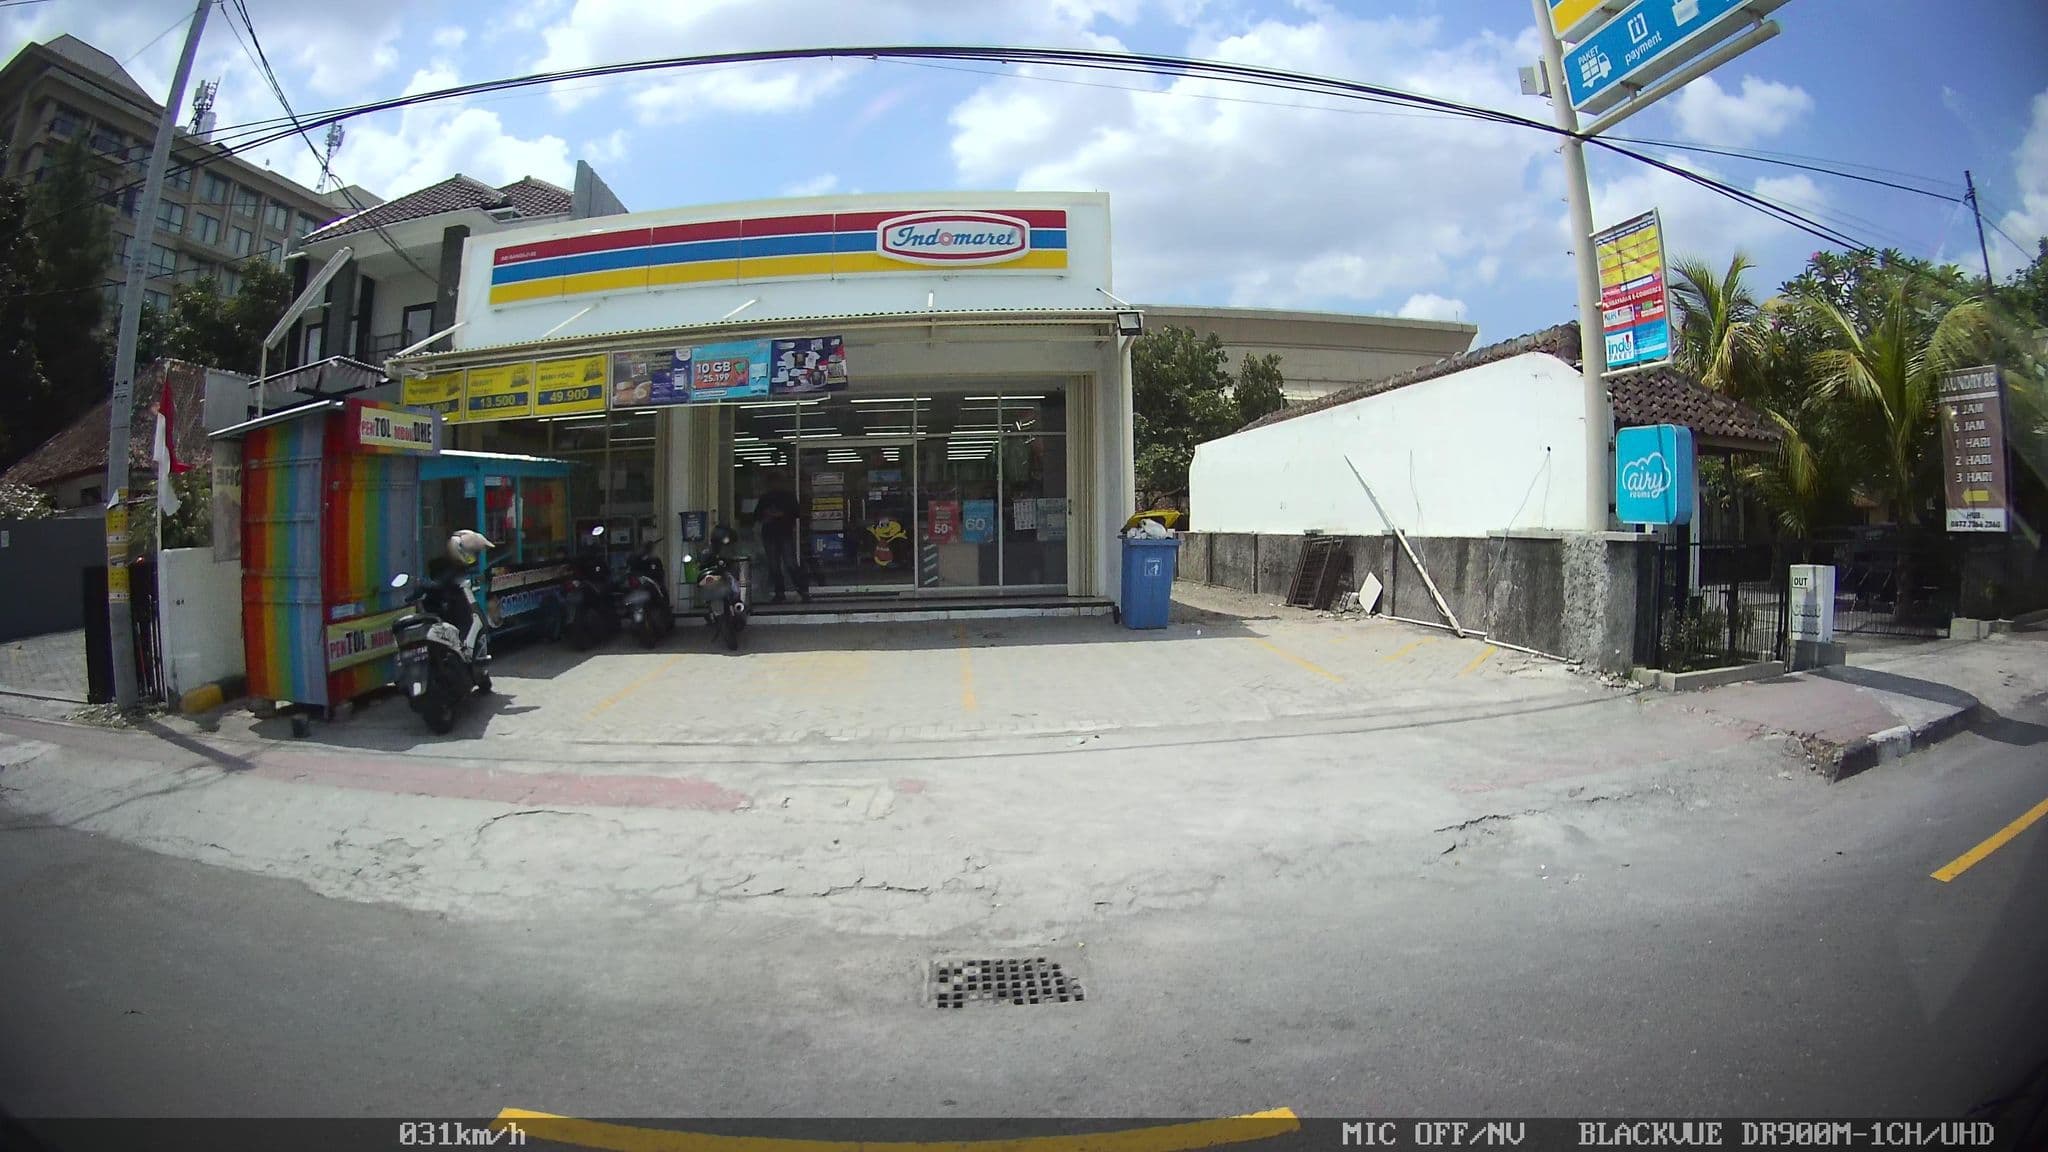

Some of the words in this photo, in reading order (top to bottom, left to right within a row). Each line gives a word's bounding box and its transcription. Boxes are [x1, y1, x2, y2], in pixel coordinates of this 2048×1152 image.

[1578, 45, 1599, 64] PAKET
[1625, 31, 1663, 66] payment
[893, 226, 1015, 247] Indomaret
[696, 363, 709, 374] 10
[712, 361, 731, 373] GB
[1940, 374, 1981, 392] LAUNDRY
[550, 387, 589, 402] 49.900
[1962, 402, 1984, 415] JAM
[1953, 422, 1960, 432] 6
[1964, 419, 1985, 432] JAM
[1955, 439, 1960, 449] 1
[1965, 437, 1991, 448] HARI
[1955, 455, 1962, 466] 2
[1966, 454, 1992, 465] HARI
[1627, 466, 1668, 498] airy
[1956, 472, 1963, 483] 3
[1966, 471, 1993, 483] HARI
[1794, 577, 1808, 586] OUT
